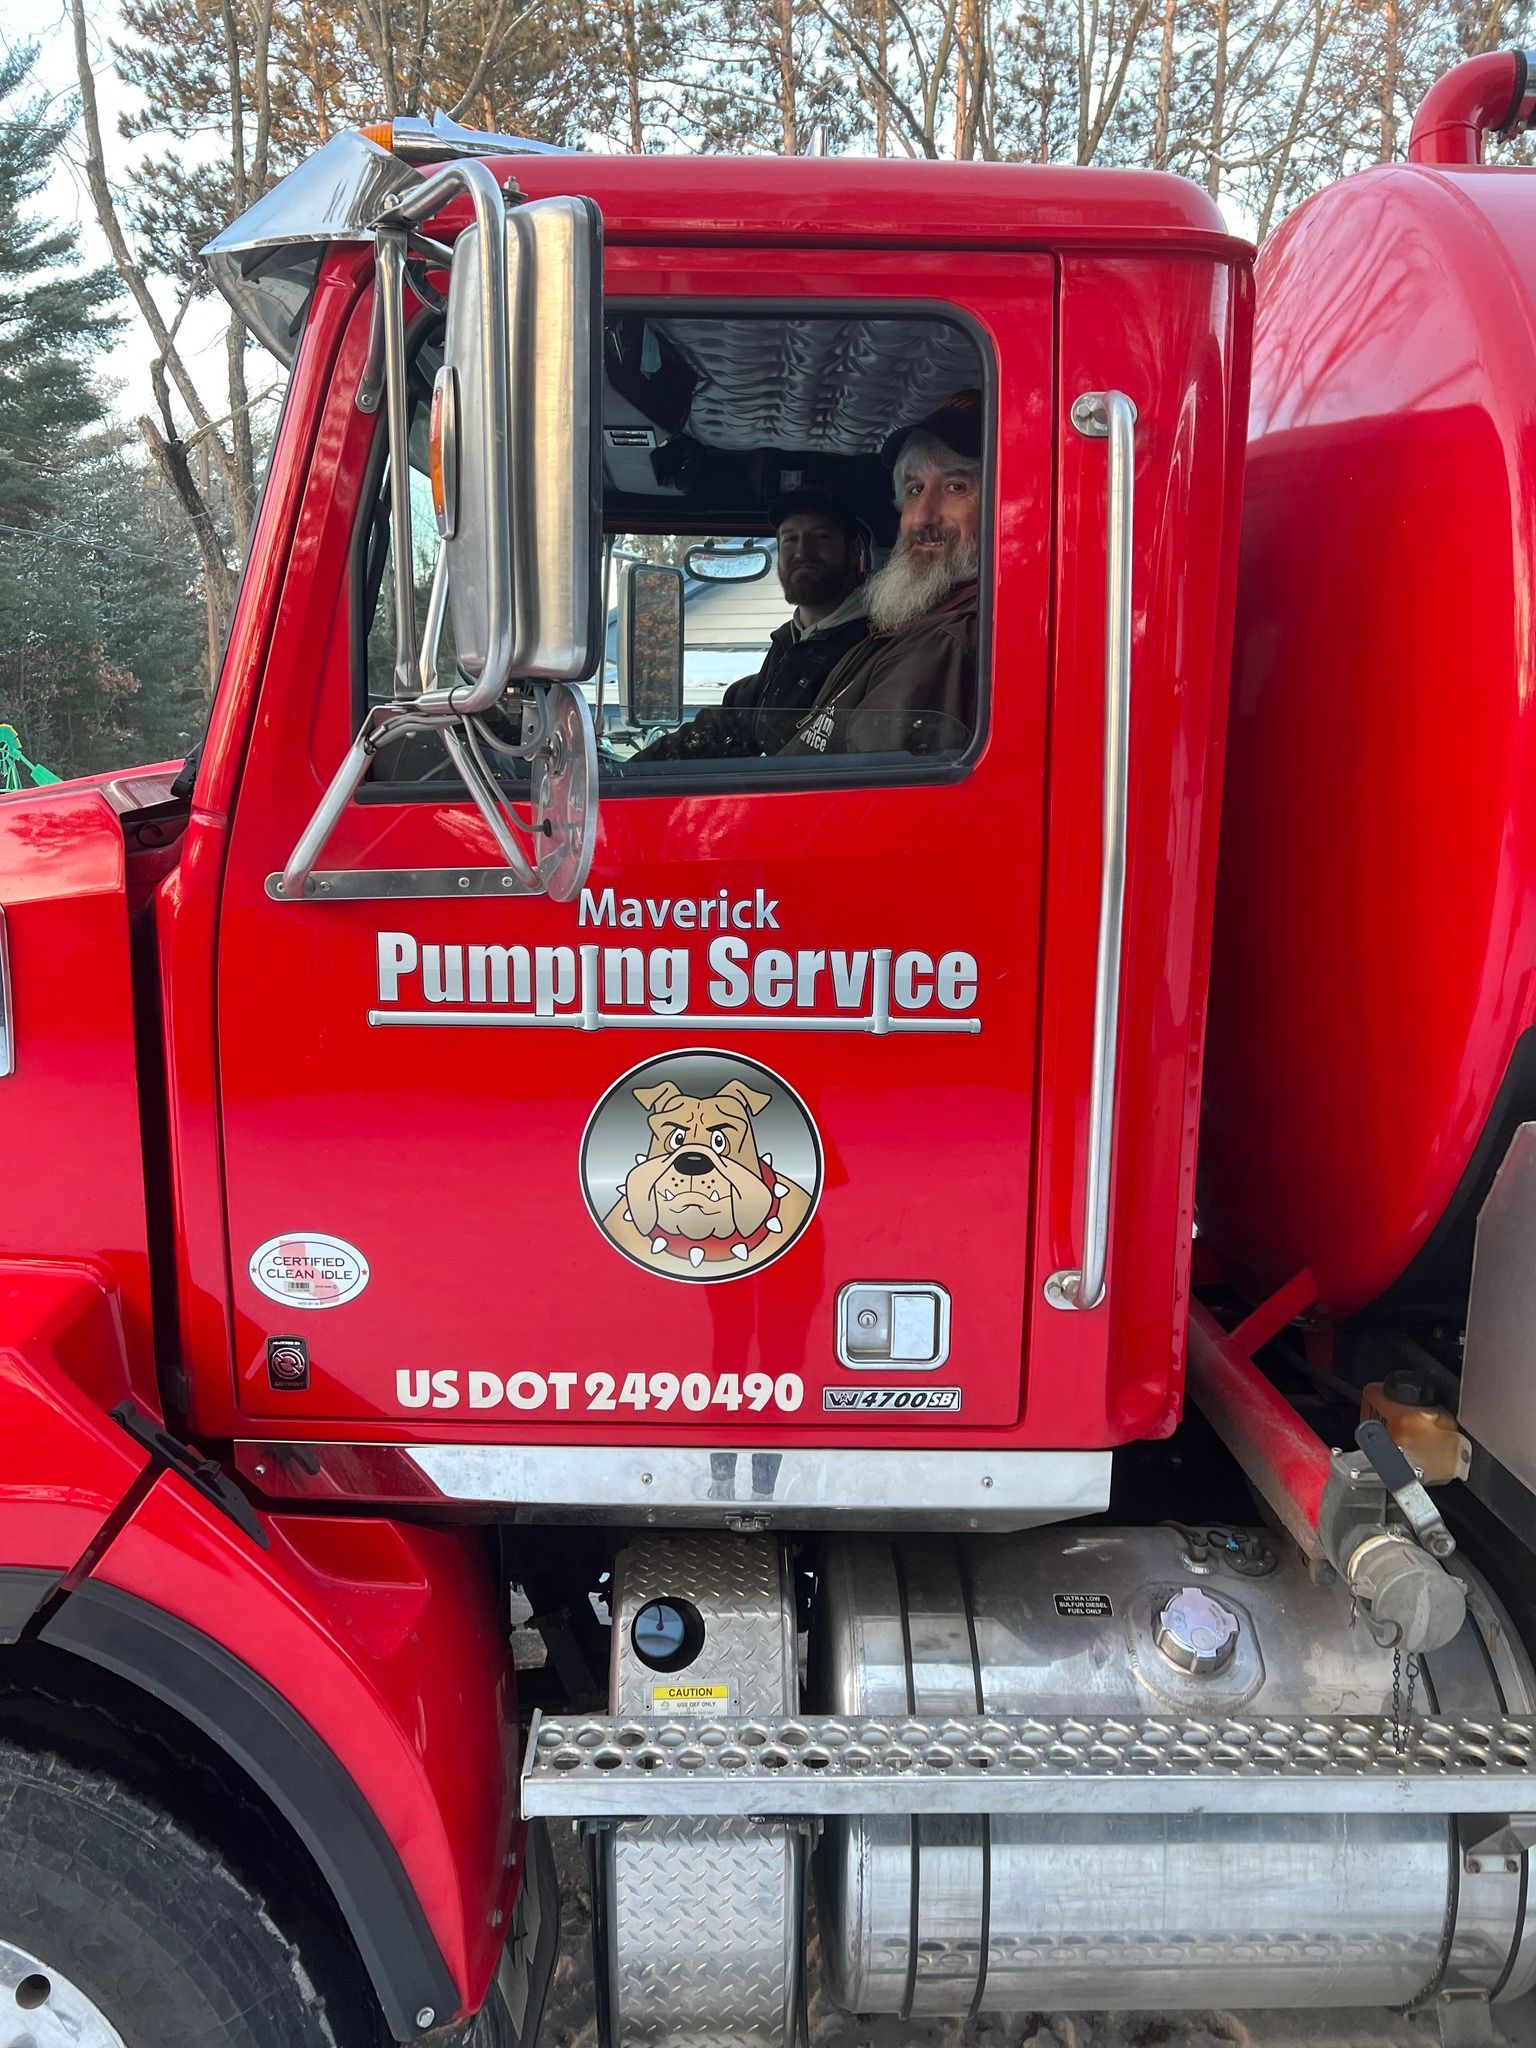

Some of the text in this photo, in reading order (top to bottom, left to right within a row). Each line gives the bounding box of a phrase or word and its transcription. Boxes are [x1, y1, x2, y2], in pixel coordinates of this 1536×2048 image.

[578, 888, 780, 929] Maverick
[377, 931, 979, 1030] Pumping Service
[266, 1268, 353, 1280] CLEAN IDLE
[272, 1256, 345, 1267] CERTIFIED
[396, 1369, 805, 1412] US DOT 2490490
[668, 1687, 713, 1697] CAUTION
